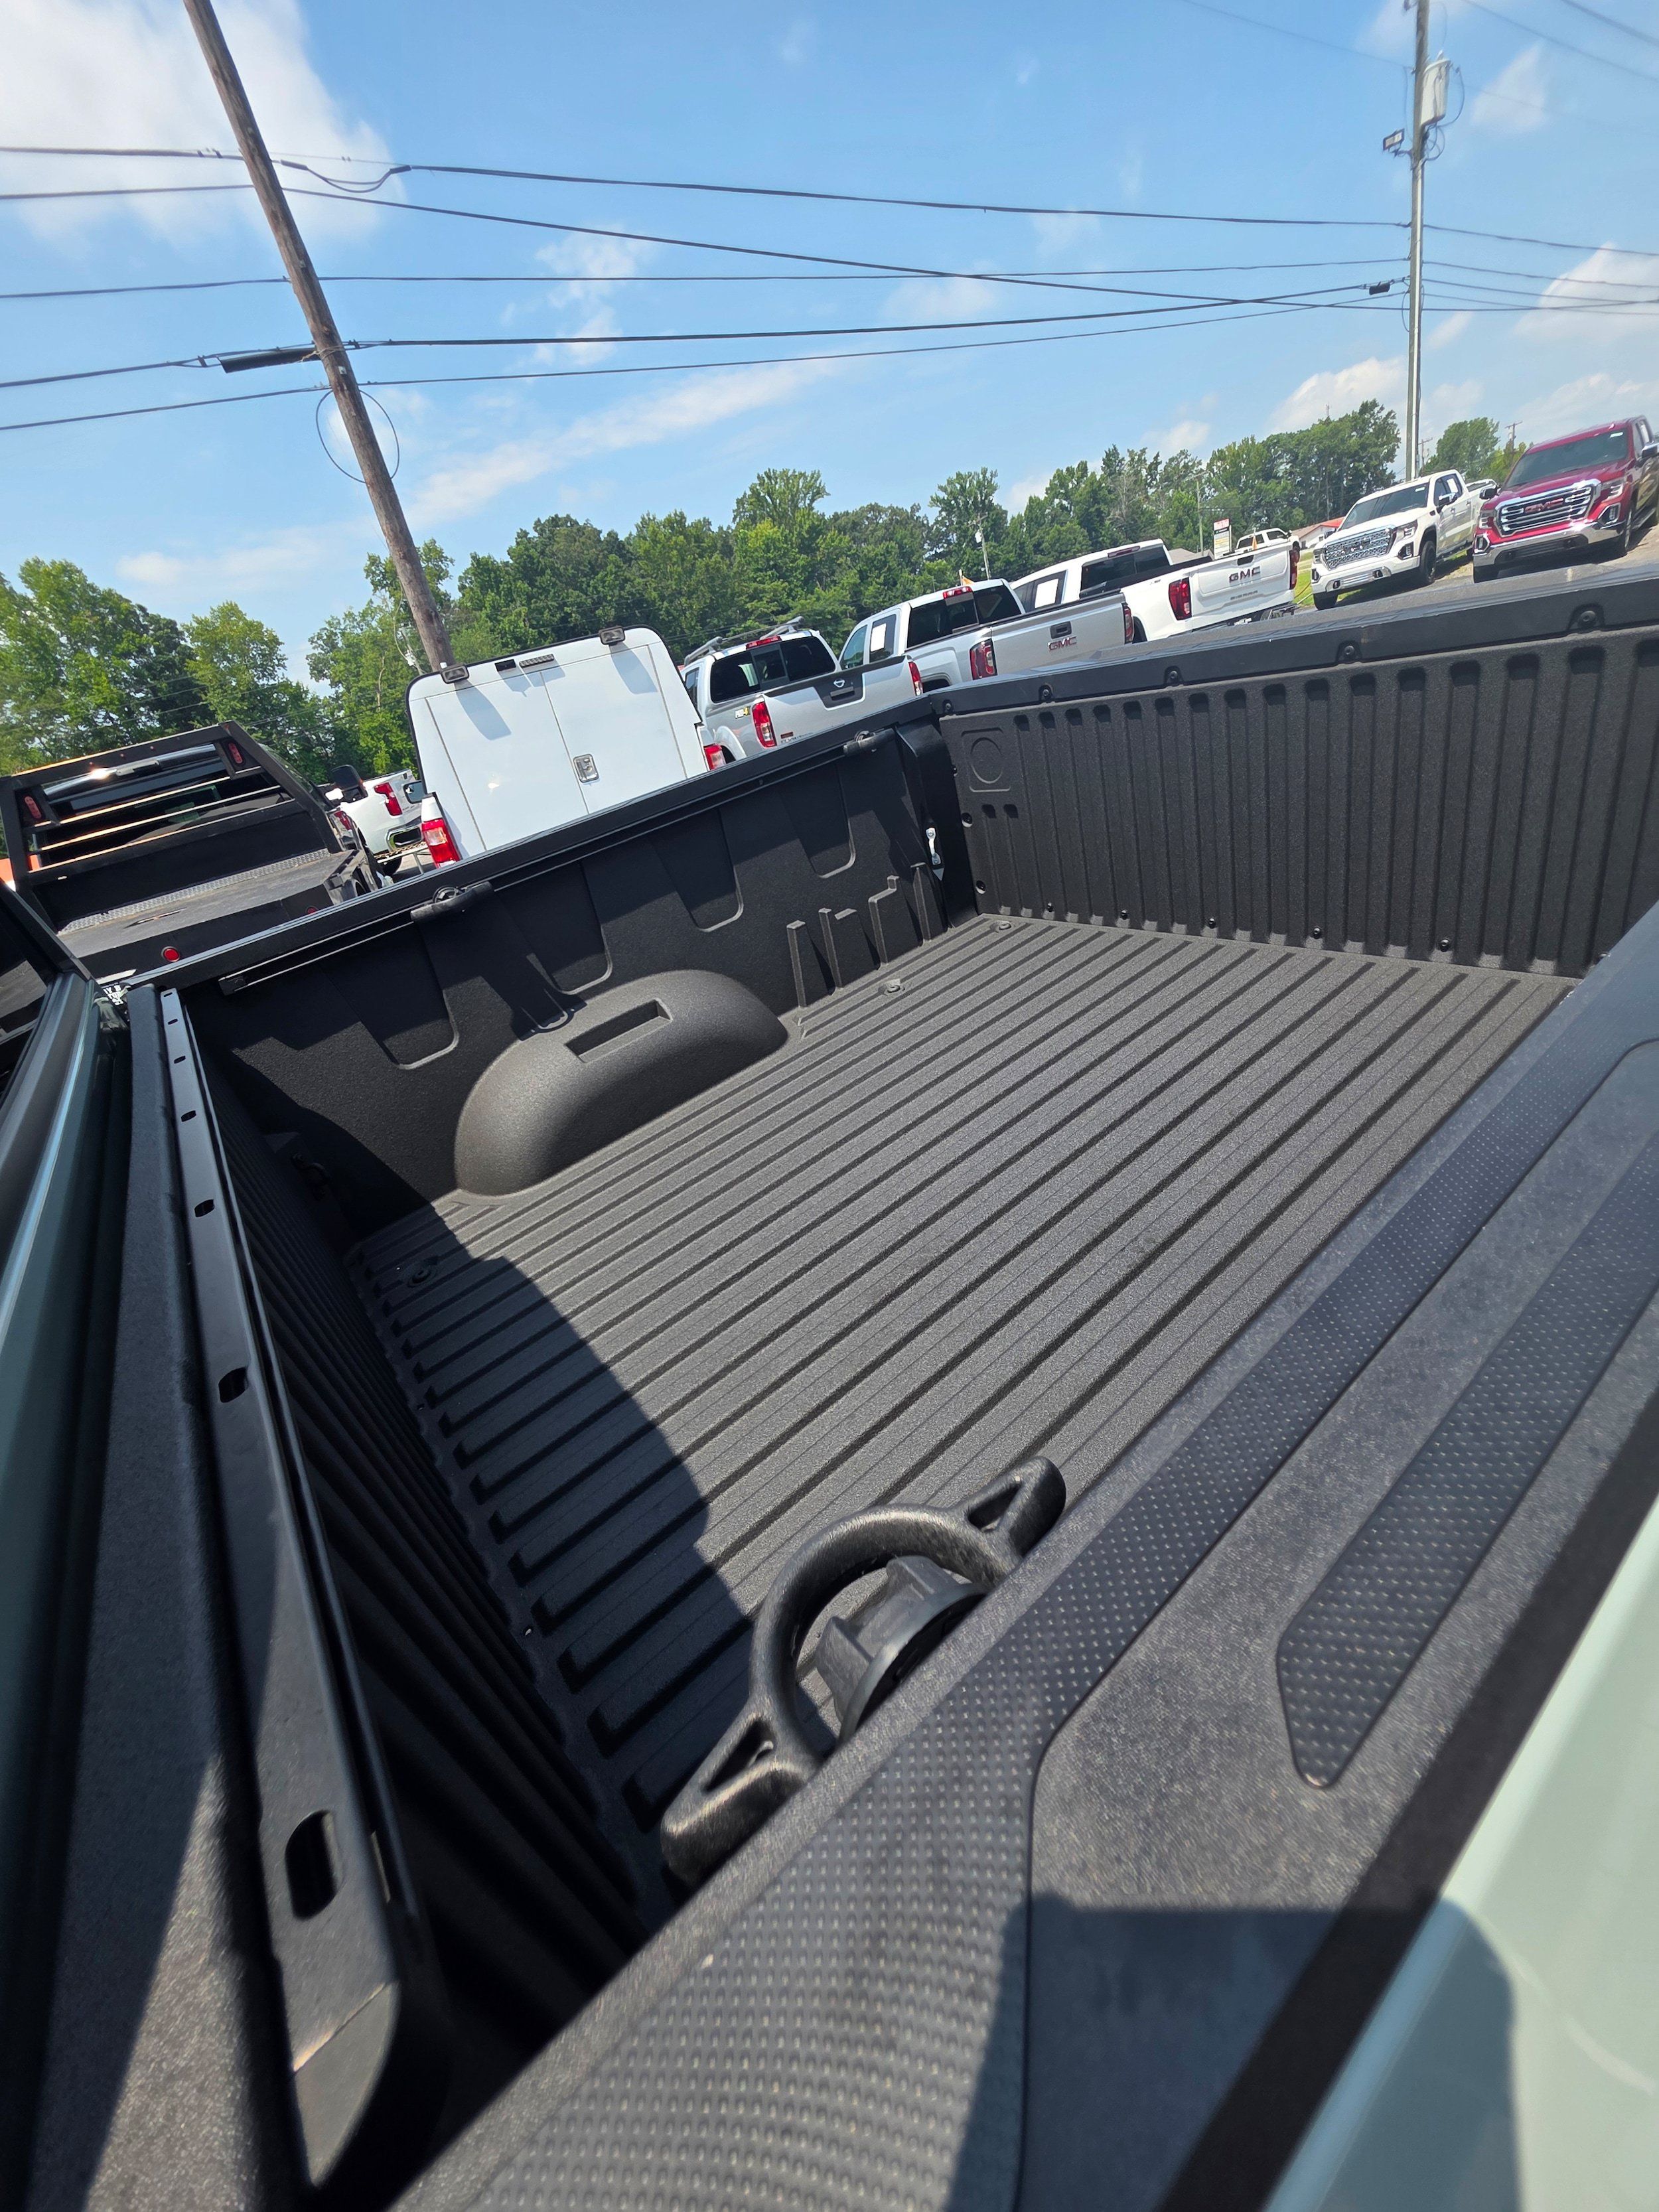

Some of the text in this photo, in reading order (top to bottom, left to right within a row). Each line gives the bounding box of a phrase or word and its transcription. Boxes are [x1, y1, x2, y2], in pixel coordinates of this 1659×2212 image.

[1525, 498, 1563, 513] GMC
[1228, 566, 1261, 583] GMC
[1047, 636, 1077, 651] GMC
